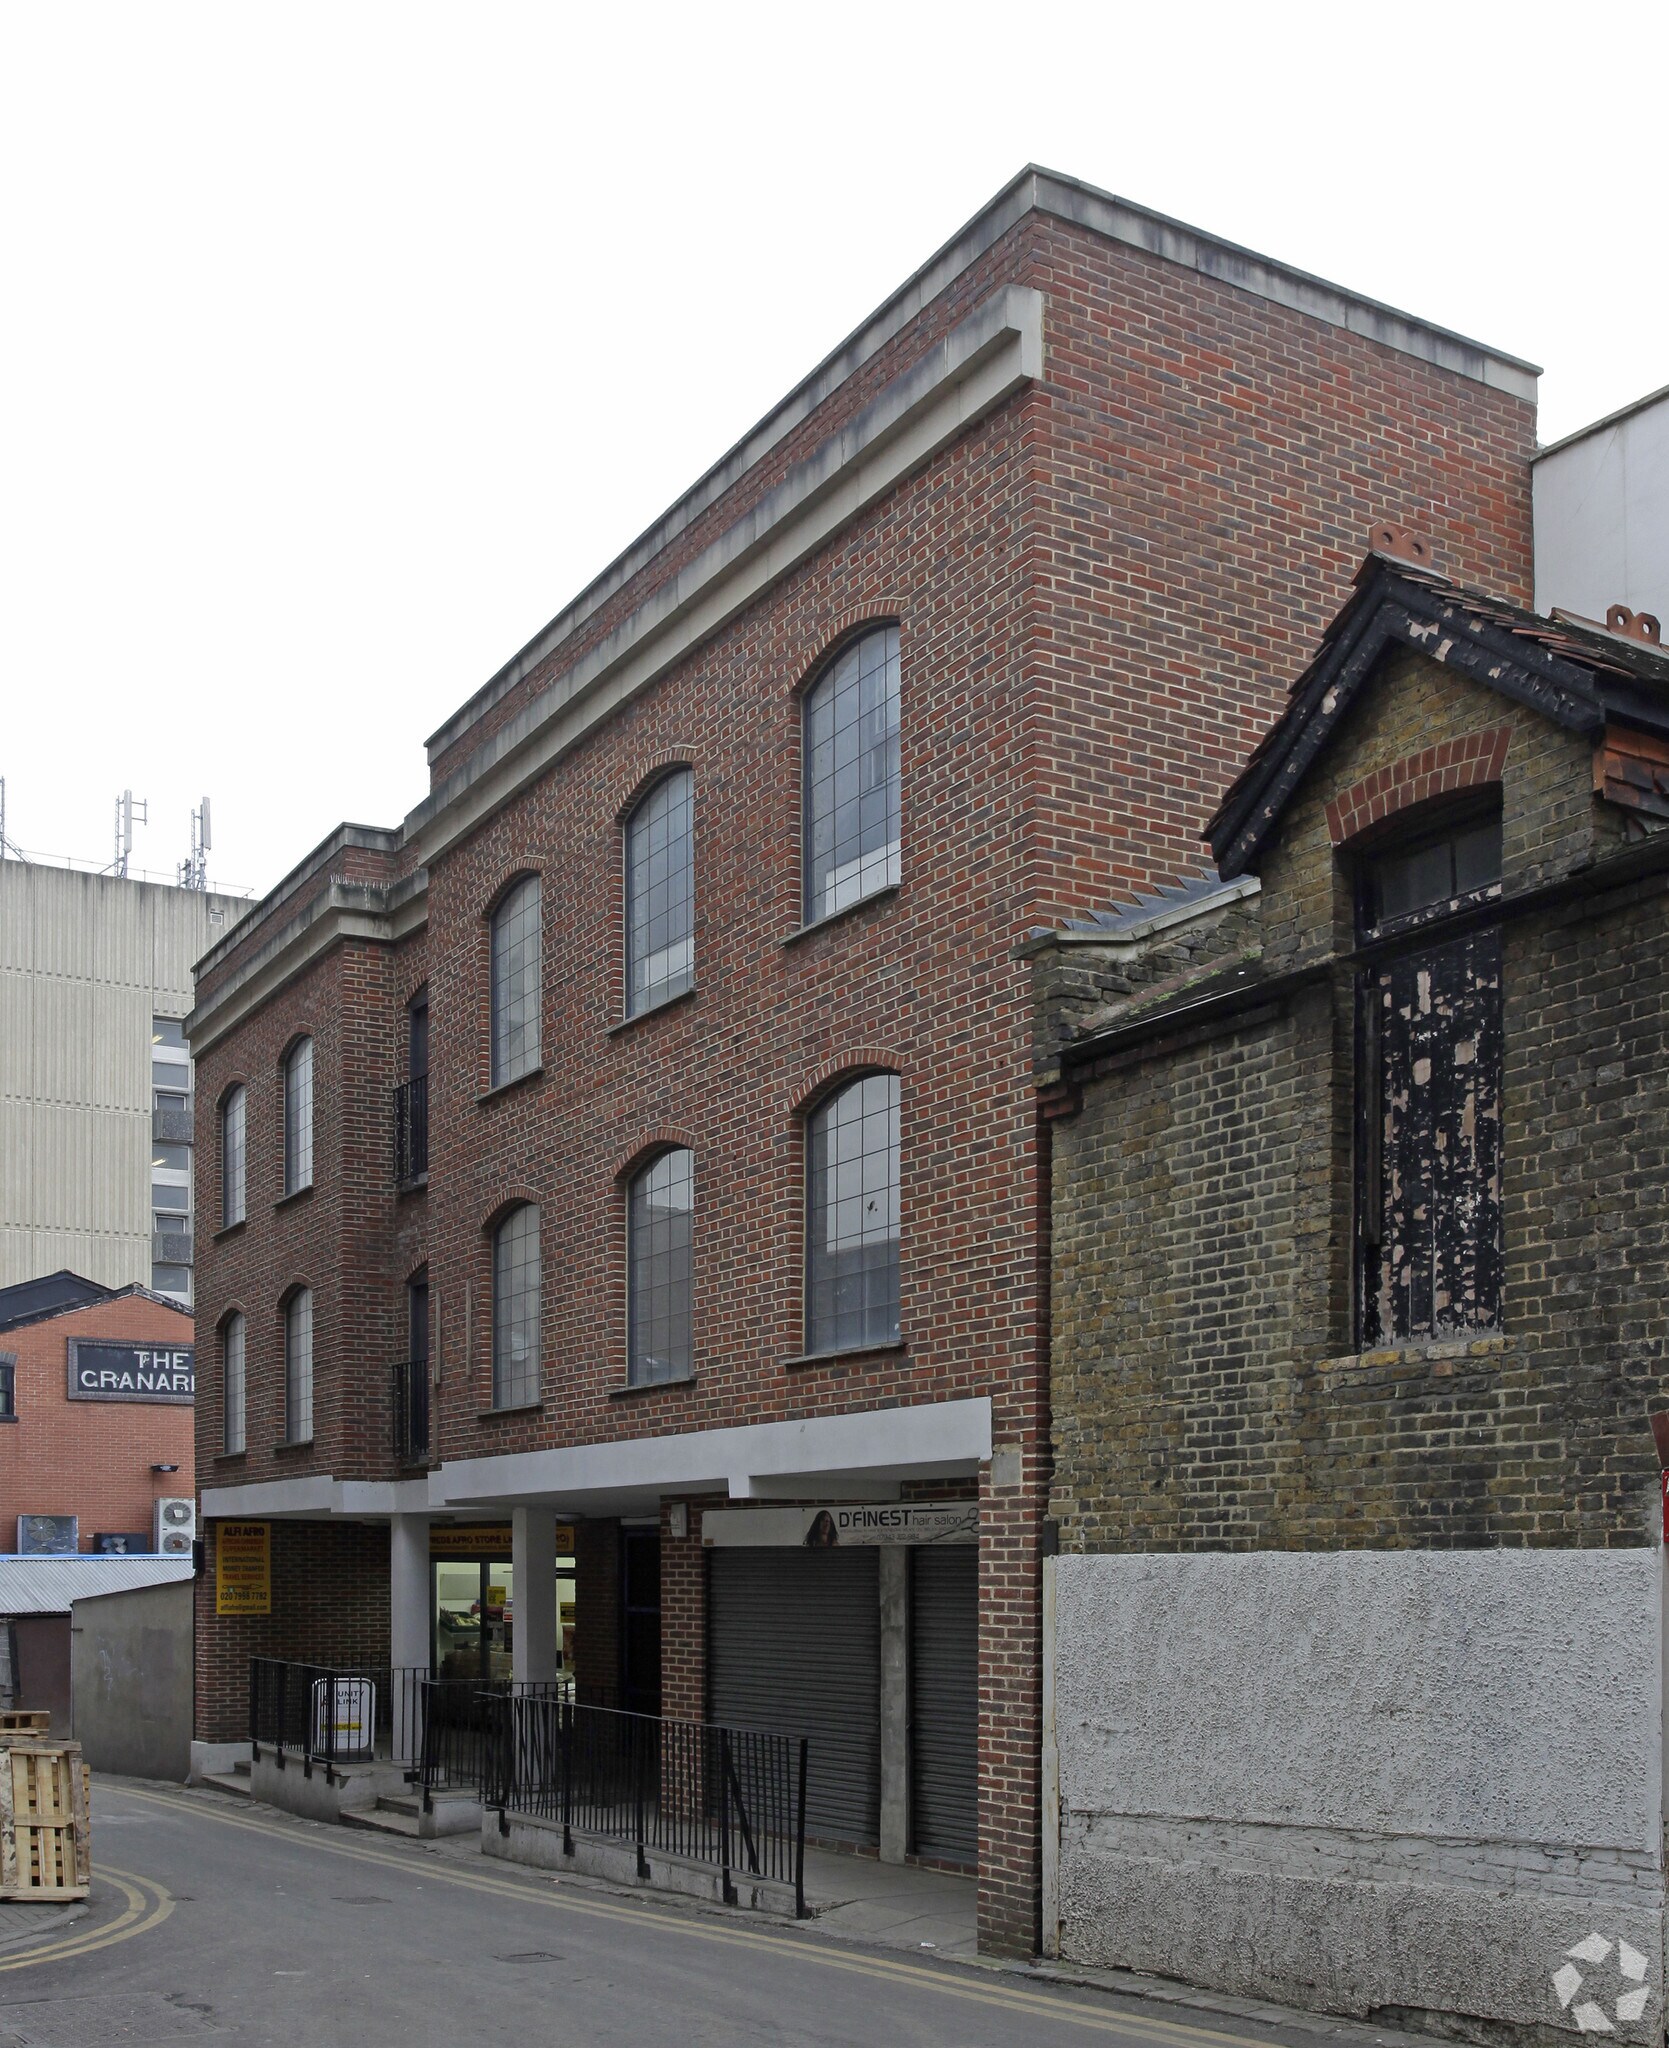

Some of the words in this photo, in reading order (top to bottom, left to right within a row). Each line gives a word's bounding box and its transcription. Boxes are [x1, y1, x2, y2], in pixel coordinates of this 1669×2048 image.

[134, 1351, 189, 1370] THE
[912, 1515, 932, 1526] hair
[934, 1514, 962, 1526] salon
[243, 1527, 265, 1537] AFRO
[452, 1536, 473, 1544] AFRO
[475, 1535, 501, 1544] STORE
[220, 1592, 233, 1600] 020
